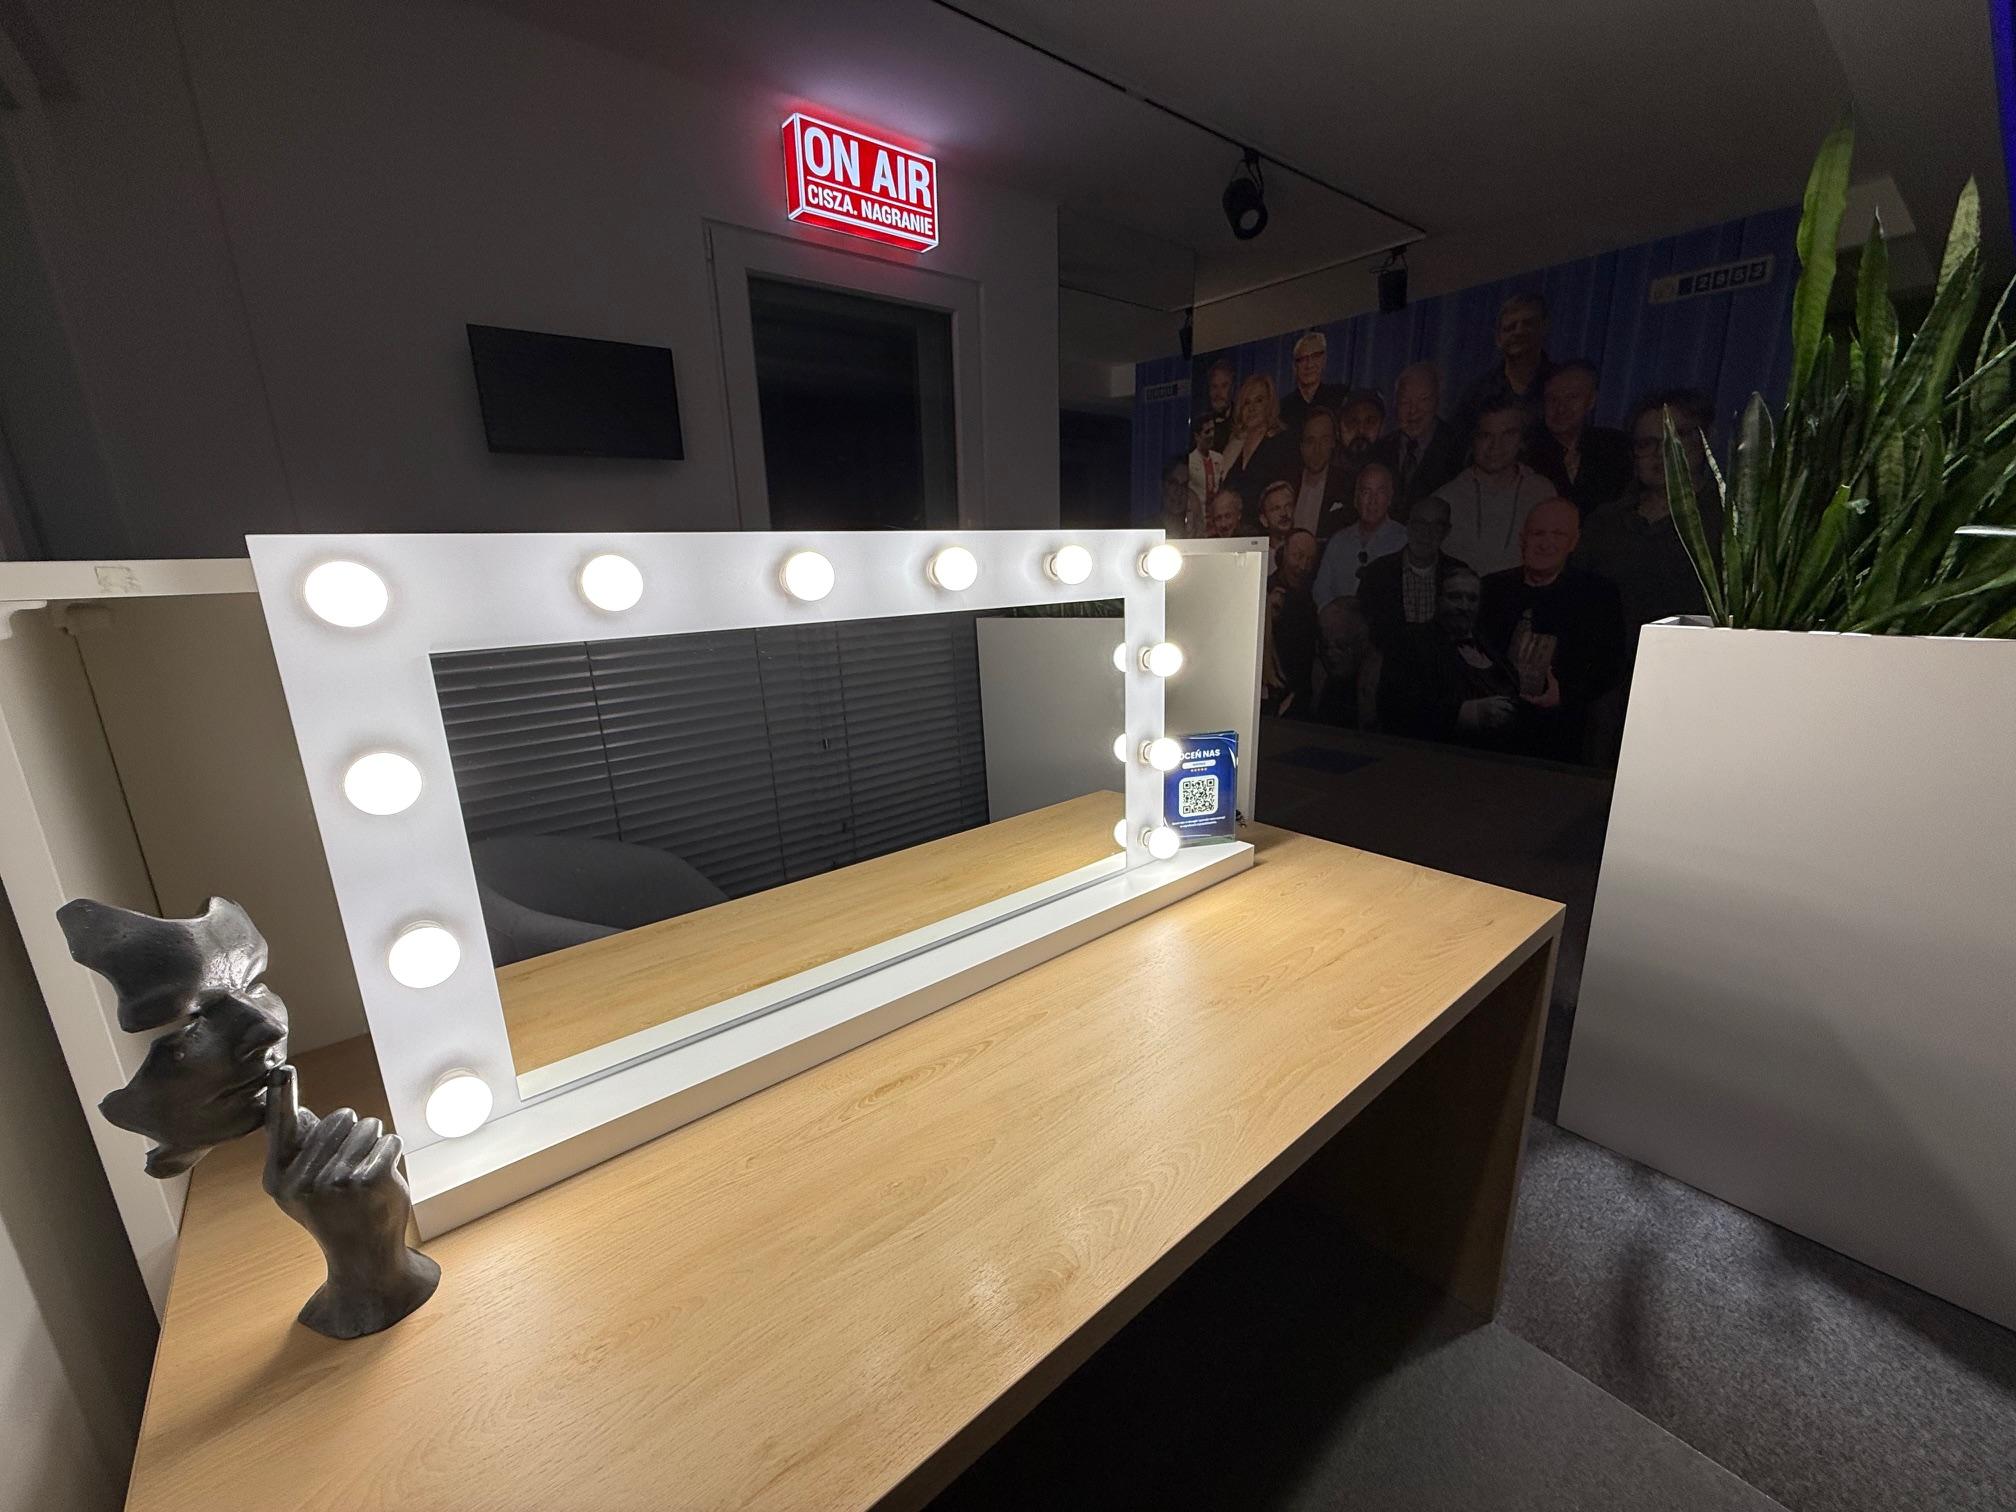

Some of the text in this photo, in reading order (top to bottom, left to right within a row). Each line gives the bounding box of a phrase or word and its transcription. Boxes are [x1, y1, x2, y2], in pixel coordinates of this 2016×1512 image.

[804, 126, 932, 208] ON AIR
[807, 184, 934, 236] CISZA. NAGRANIE
[1203, 749, 1220, 759] NAS
